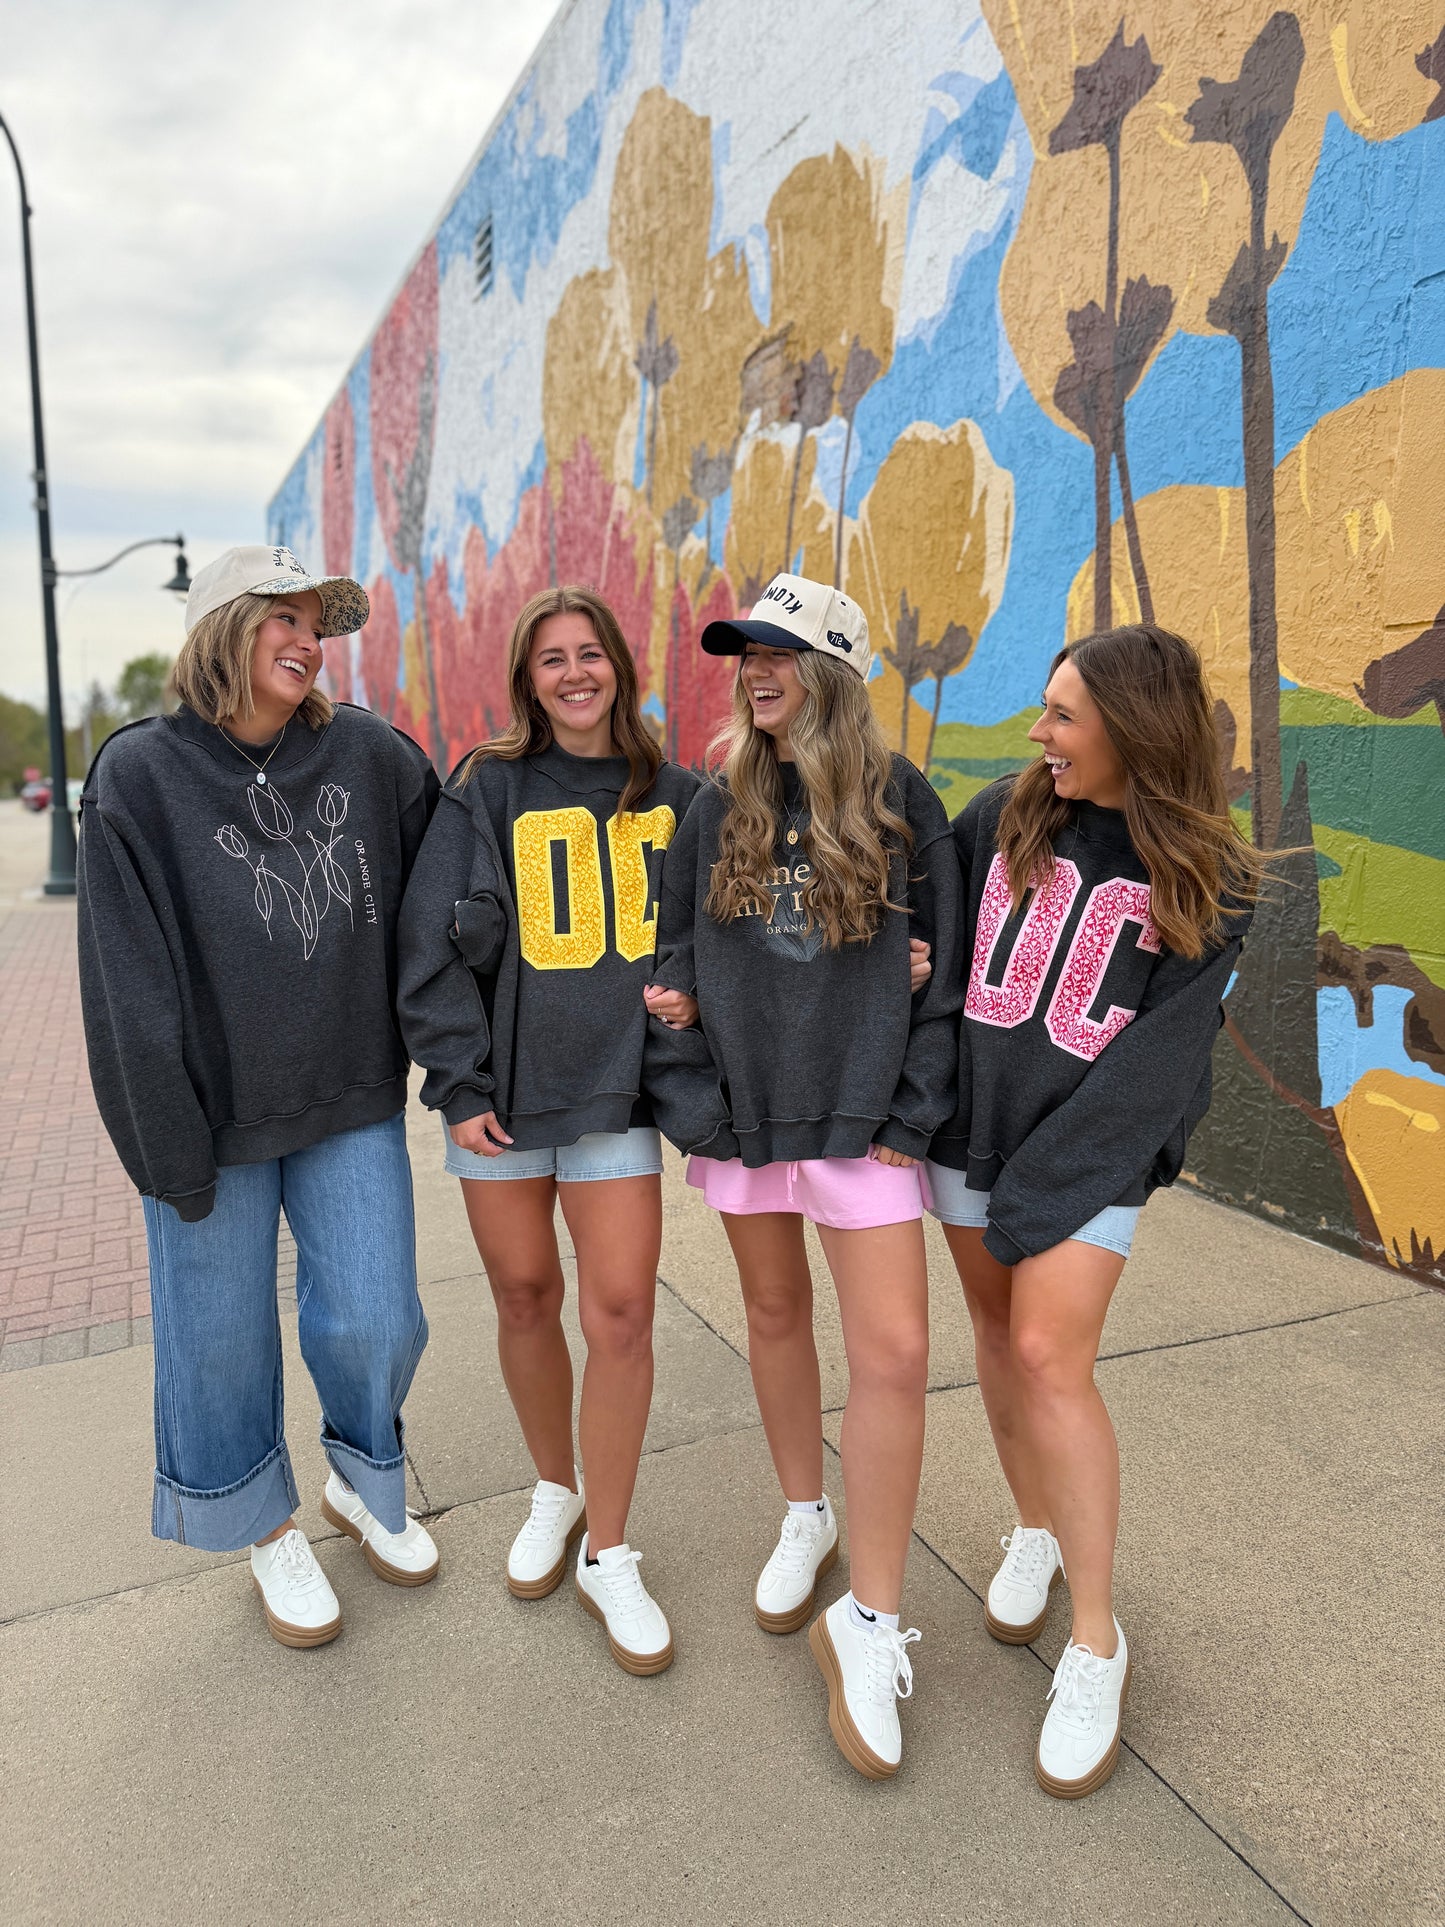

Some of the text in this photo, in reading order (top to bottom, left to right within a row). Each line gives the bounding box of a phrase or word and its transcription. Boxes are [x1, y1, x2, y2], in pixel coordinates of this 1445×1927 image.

[830, 633, 843, 646] 712
[354, 839, 378, 925] ORANGE CITY
[513, 804, 677, 971] OC
[766, 923, 814, 935] ORANG
[963, 850, 1162, 1063] OC
